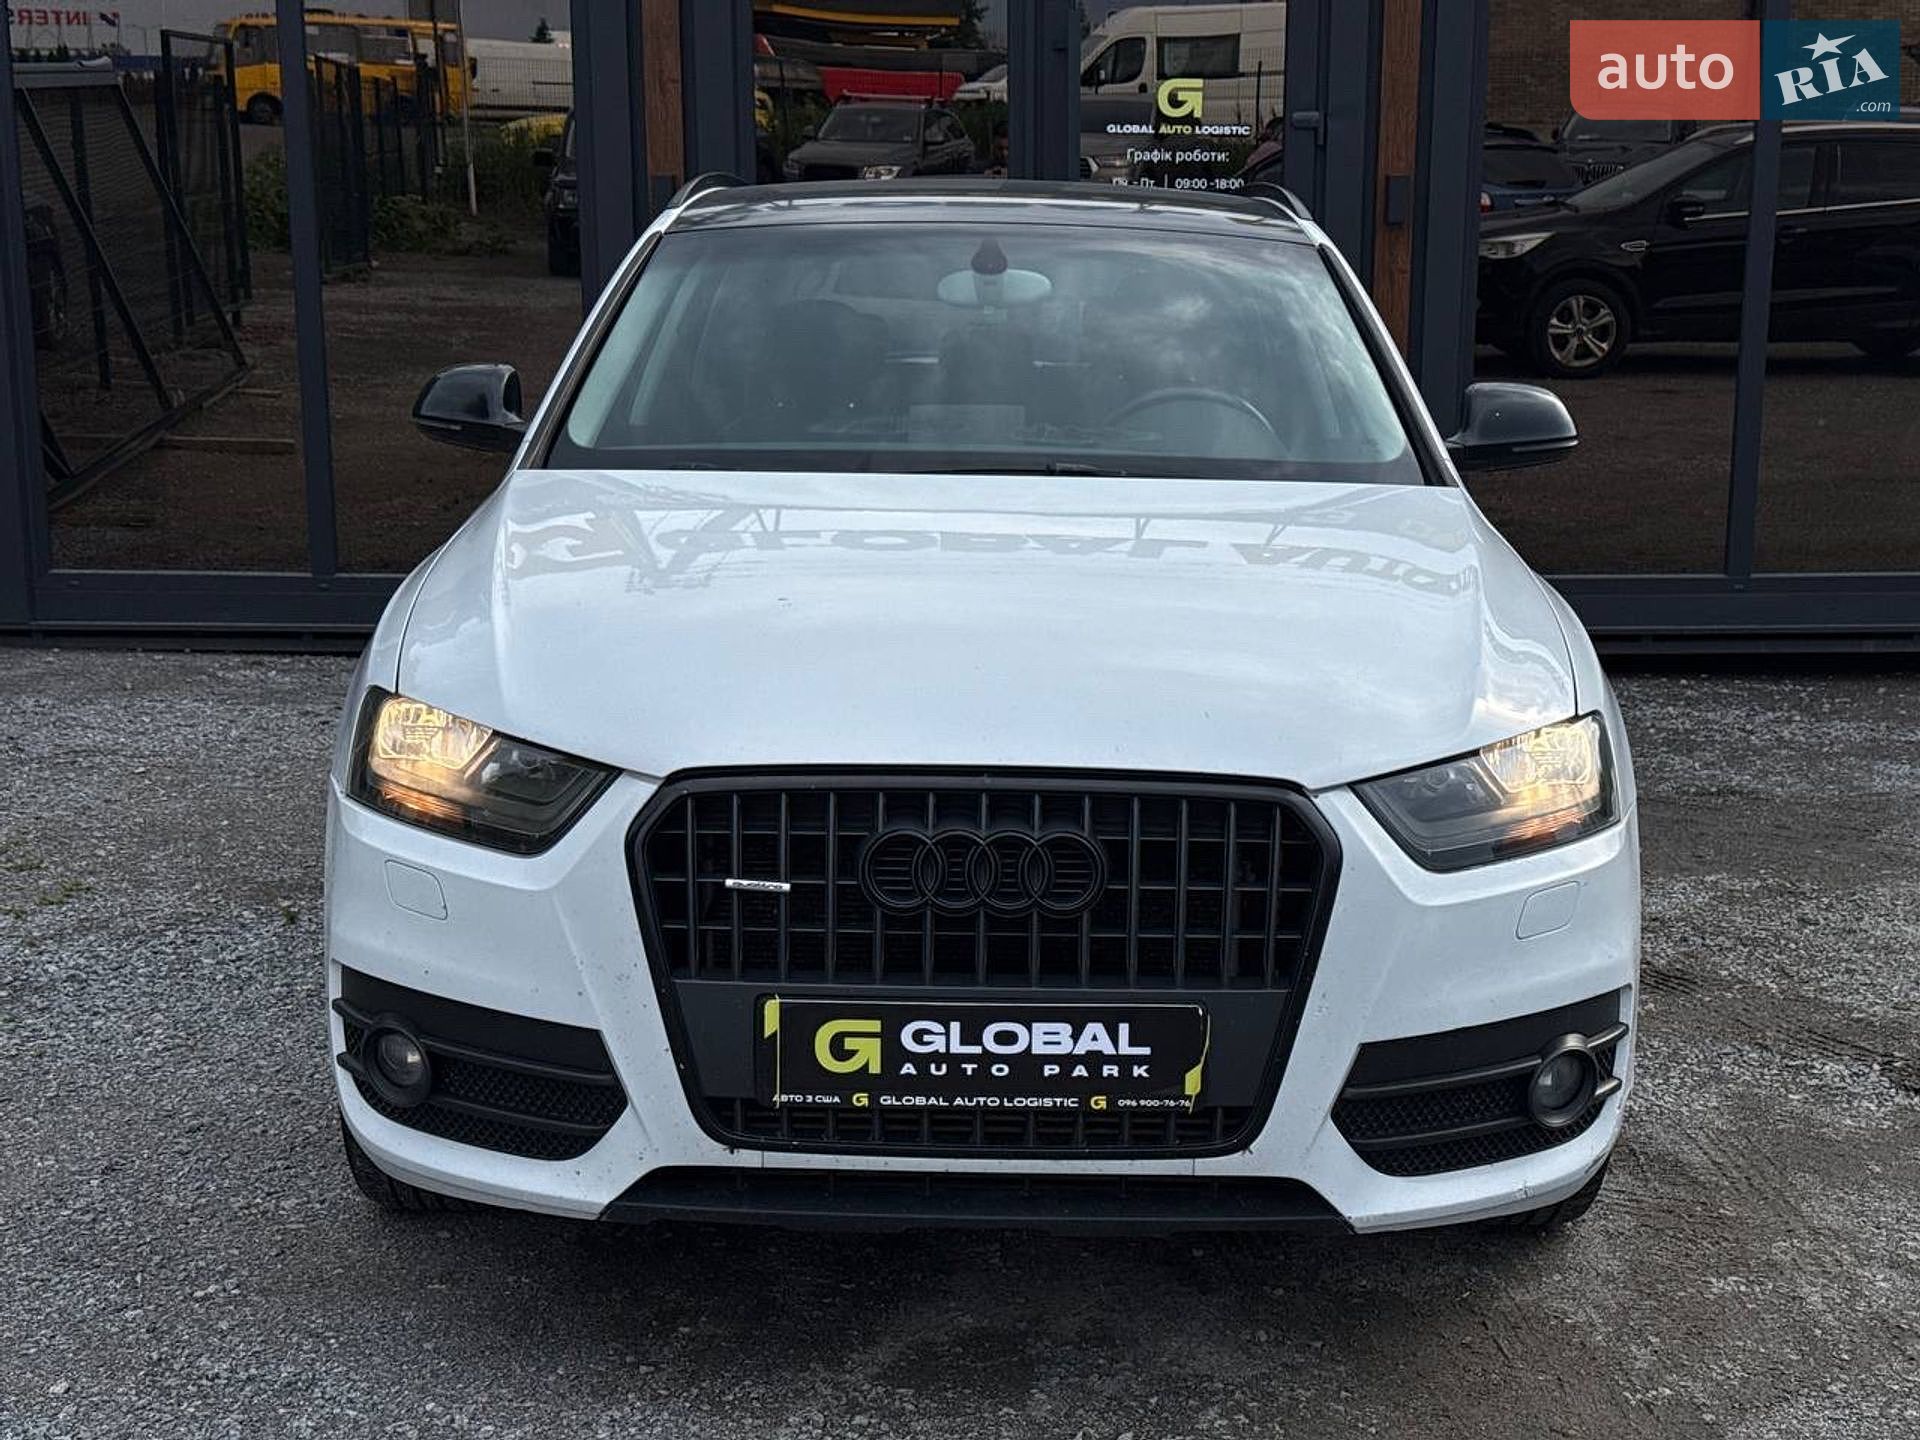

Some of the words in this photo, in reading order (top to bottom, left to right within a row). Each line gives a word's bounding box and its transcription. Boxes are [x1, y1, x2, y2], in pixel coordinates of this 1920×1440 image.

[1106, 124, 1155, 134] GLOBAL
[1158, 124, 1193, 135] AUTO
[1195, 124, 1251, 136] LOGISTIC
[1126, 148, 1173, 164] Графік
[1175, 148, 1230, 165] роботи:
[899, 1019, 1152, 1057] GLOBAL
[899, 1062, 1011, 1078] AUTO
[1043, 1063, 1152, 1079] PARK
[879, 1095, 950, 1106] GLOBAL
[952, 1096, 1001, 1107] AUTO
[1003, 1097, 1080, 1108] LOGISTIC
